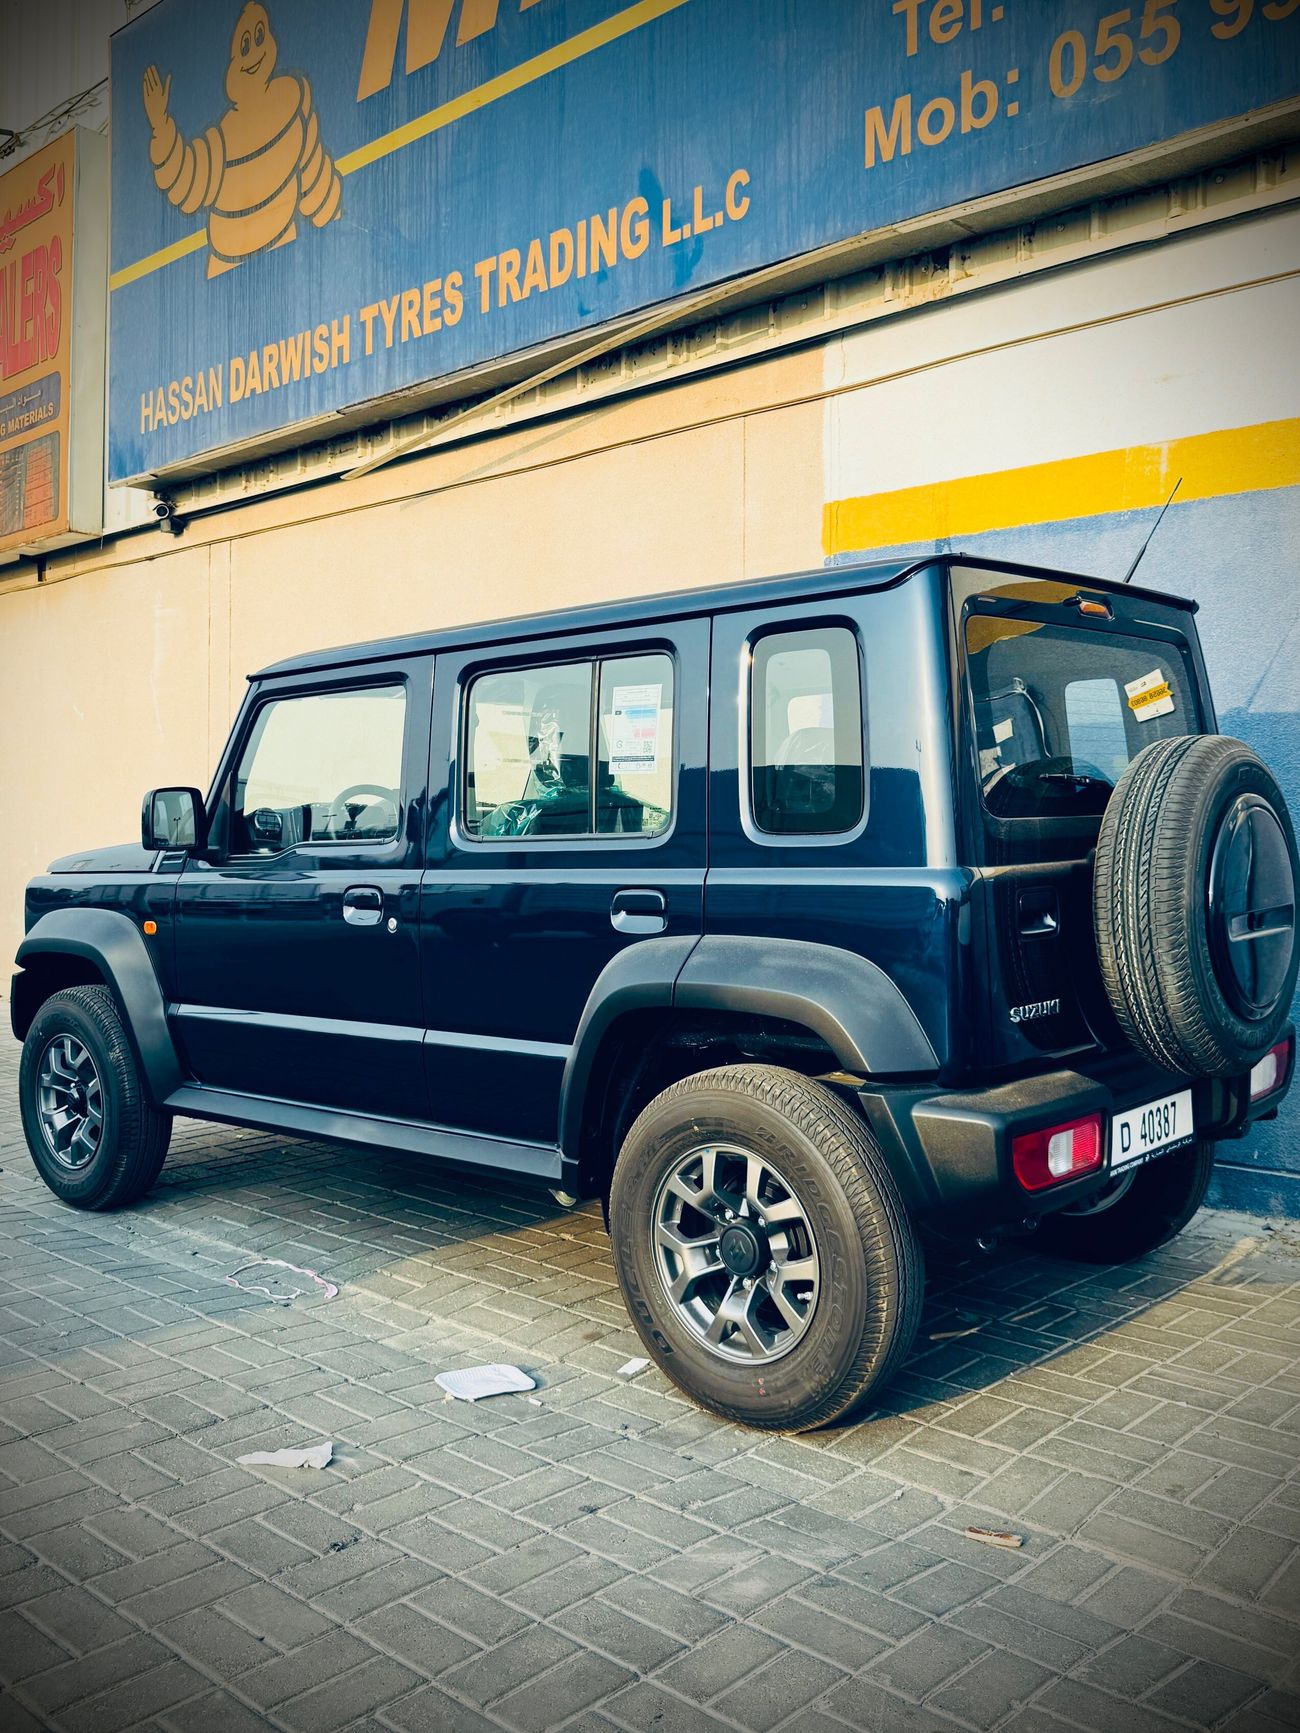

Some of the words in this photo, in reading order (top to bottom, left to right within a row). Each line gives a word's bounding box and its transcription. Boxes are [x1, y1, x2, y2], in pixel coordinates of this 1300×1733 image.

[864, 69, 1019, 169] Mob:
[1049, 0, 1181, 98] 055
[1210, 0, 1300, 40] 9
[140, 364, 223, 435] HASSAN
[229, 315, 351, 405] DARWISH
[360, 271, 464, 356] TYRES
[474, 196, 650, 314] TRADING
[662, 169, 751, 247] L.L.C
[7, 401, 54, 433] MATERIALS
[1009, 998, 1060, 1023] SUZUKI
[1120, 1121, 1131, 1154] D
[1140, 1100, 1177, 1148] 40387
